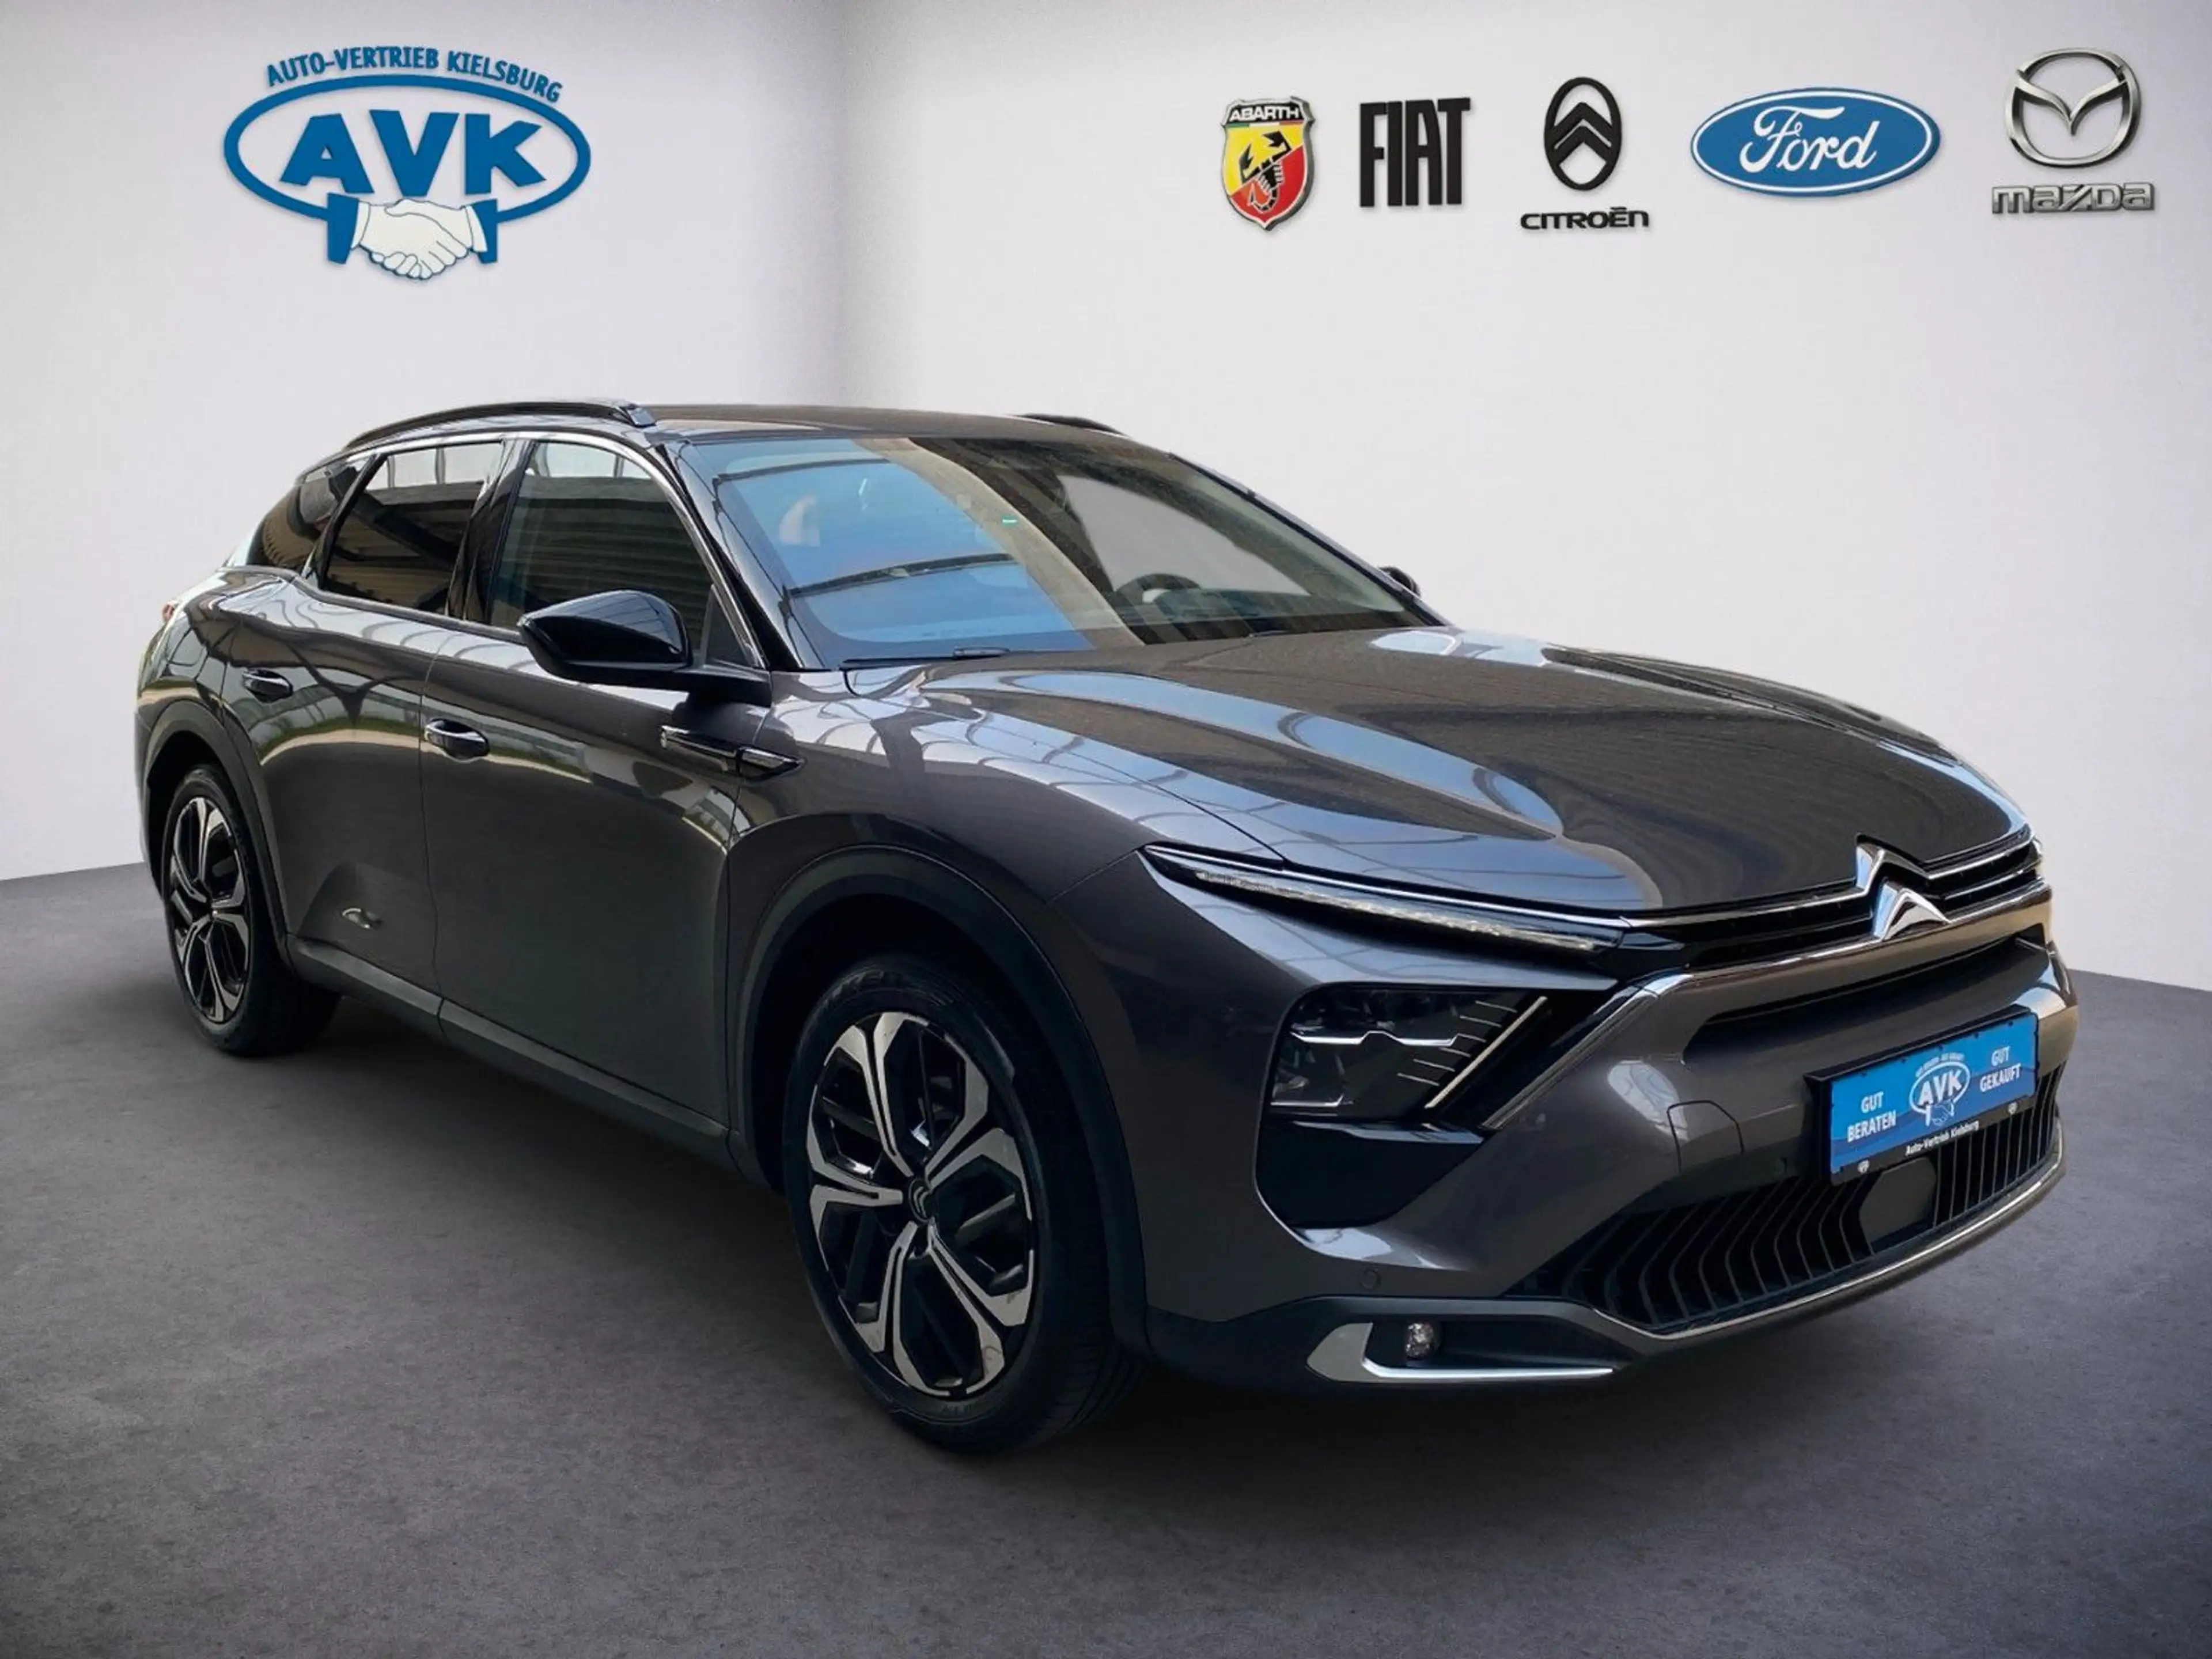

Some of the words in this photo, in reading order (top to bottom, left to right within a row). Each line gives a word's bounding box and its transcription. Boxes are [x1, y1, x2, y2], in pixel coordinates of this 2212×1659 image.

[267, 46, 438, 87] AUTO-VERTRIEB
[446, 51, 563, 103] KIELSBURG
[1229, 105, 1300, 122] ABARTH
[279, 109, 546, 197] AVK
[1359, 97, 1471, 207] FIAT
[1738, 105, 1880, 173] Ford
[1520, 207, 1650, 230] CITROËN
[1991, 1047, 2010, 1066] GUT
[1918, 1070, 1962, 1106] AVK
[1980, 1064, 2021, 1092] GEKAUFT
[1861, 1092, 1884, 1113] GUT
[1847, 1110, 1896, 1143] BERATEN
